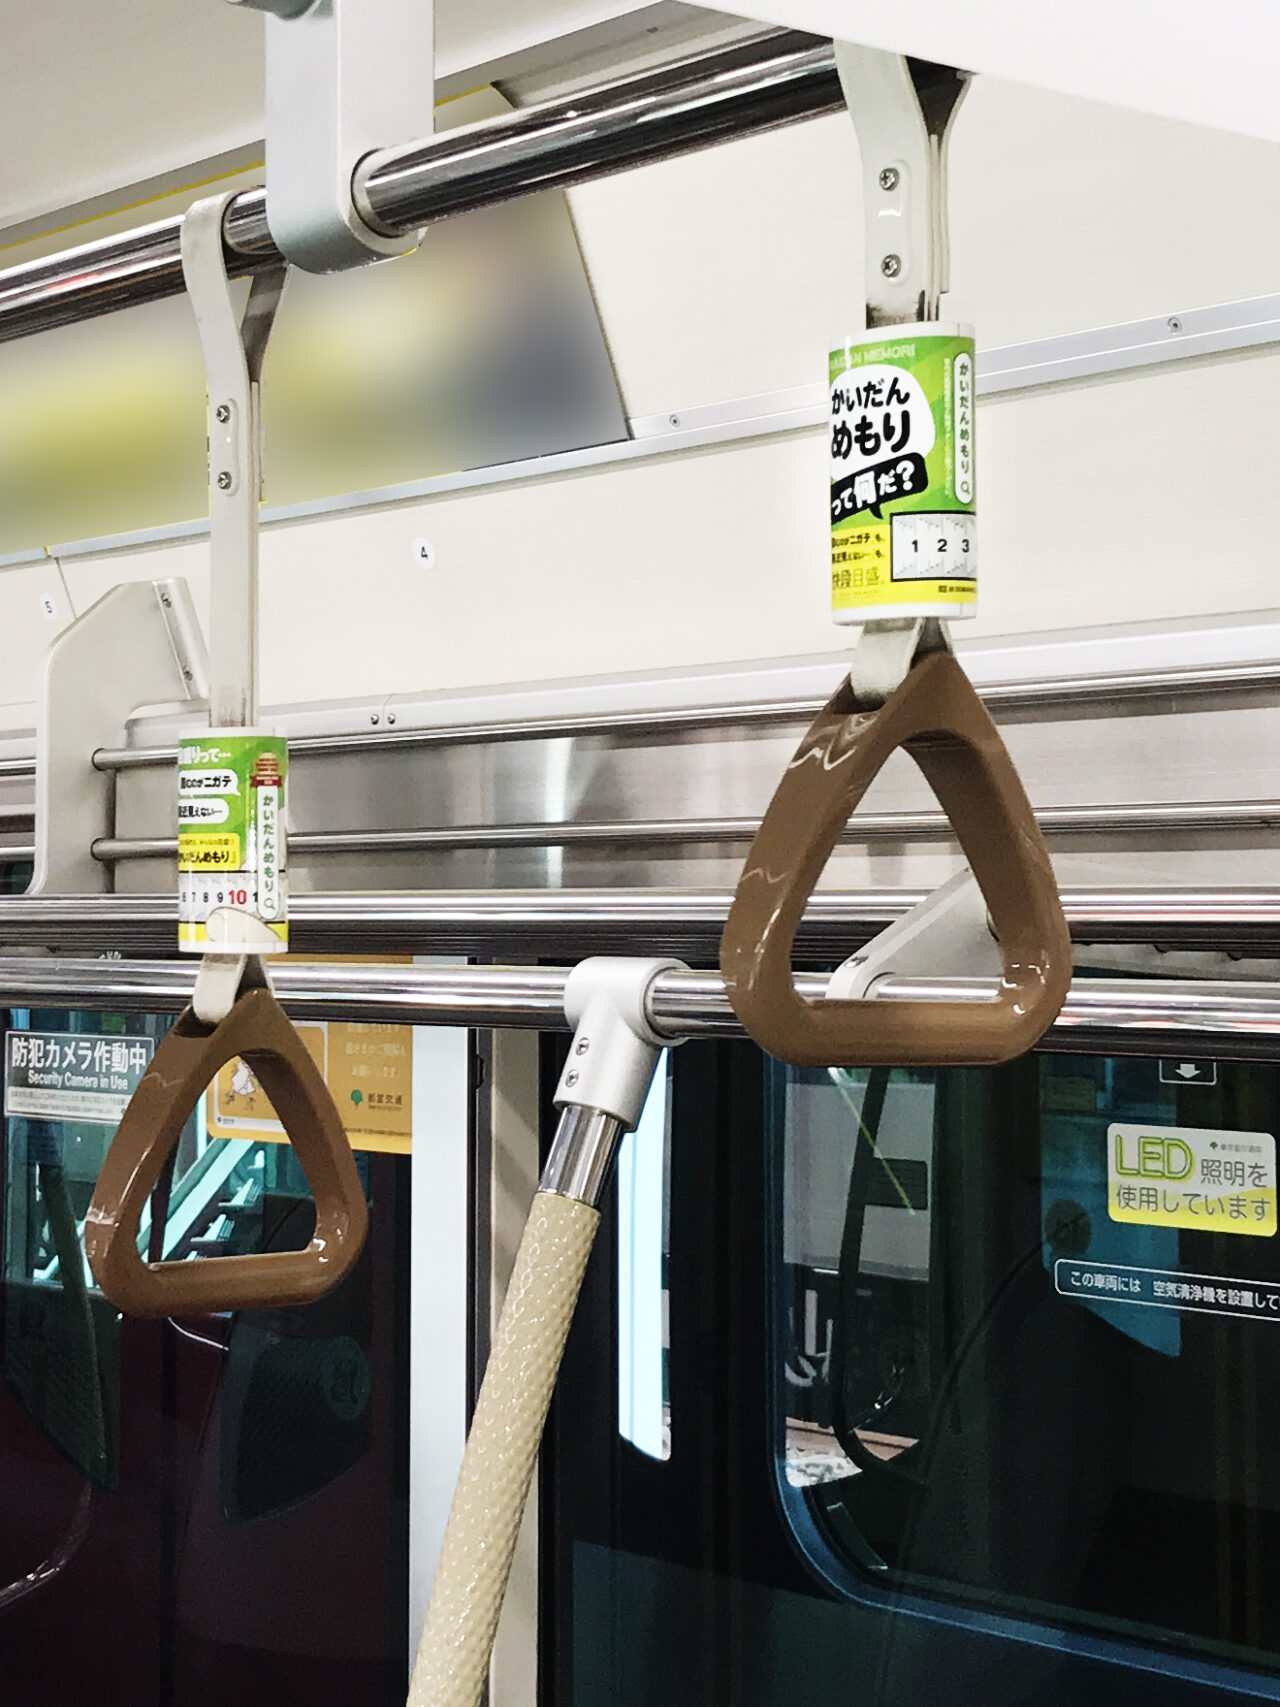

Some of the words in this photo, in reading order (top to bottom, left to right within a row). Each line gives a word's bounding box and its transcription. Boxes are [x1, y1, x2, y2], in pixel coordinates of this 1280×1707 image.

[832, 377, 910, 415] かいだん
[832, 409, 911, 460] めもり
[421, 545, 429, 561] 4
[911, 539, 918, 553] 1
[937, 538, 947, 553] 2
[961, 538, 970, 553] 3
[216, 891, 224, 903] 9
[228, 889, 247, 905] 10
[11, 1037, 147, 1075] 防犯カメラ作動中
[28, 1069, 64, 1088] Security
[64, 1071, 98, 1089] Camera
[100, 1074, 109, 1088] in
[111, 1076, 128, 1090] Use
[1115, 1134, 1194, 1180] LED
[1200, 1158, 1269, 1188] 照明を
[1116, 1183, 1271, 1222] 使用しています
[1070, 1271, 1141, 1293] この車両には
[1152, 1279, 1280, 1310] 空気清浄機を設置して
